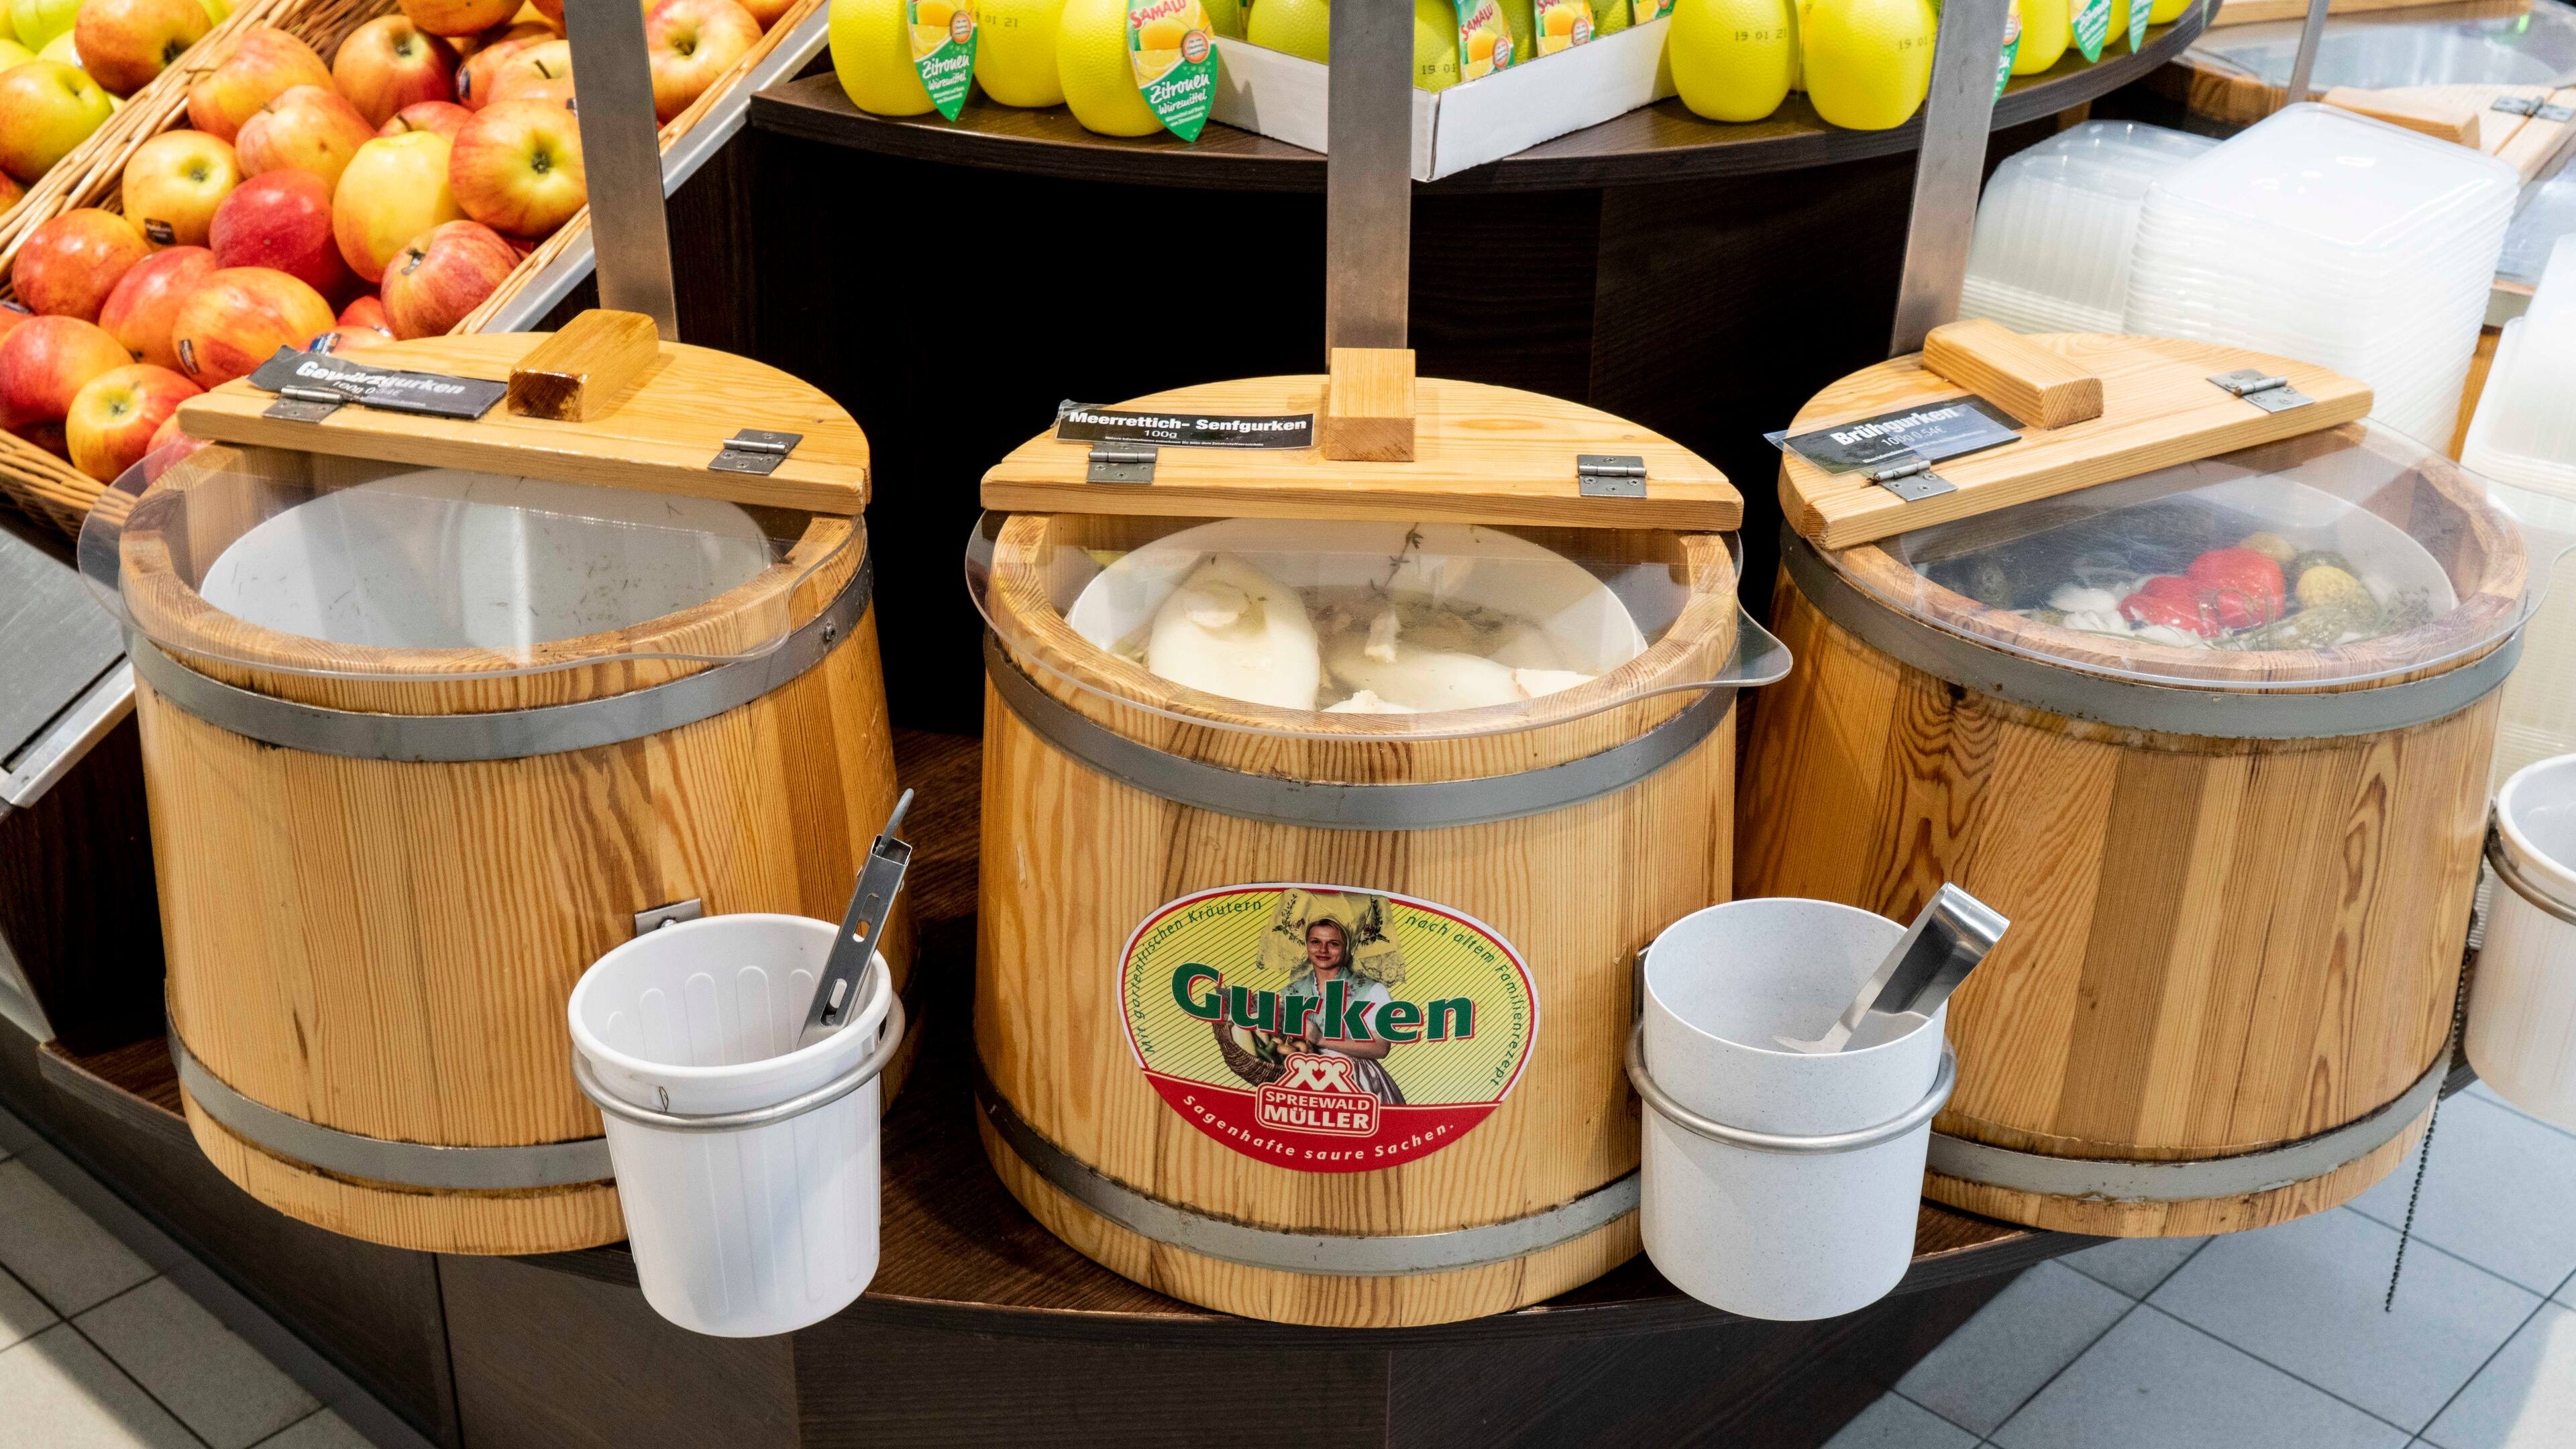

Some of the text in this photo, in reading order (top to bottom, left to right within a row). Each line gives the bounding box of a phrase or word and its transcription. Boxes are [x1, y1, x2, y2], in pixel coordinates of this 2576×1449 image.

[985, 15, 996, 25] 01
[1004, 17, 1018, 28] 21
[1130, 0, 1186, 29] SAMALU
[1460, 3, 1493, 42] SAMALU
[1735, 28, 1787, 41] 19 01 21
[1899, 39, 1911, 50] 19
[1918, 36, 1927, 46] 01
[922, 55, 970, 79] Zitronen
[1422, 64, 1456, 74] 19 01
[1150, 74, 1210, 104] Zitronen
[1159, 89, 1208, 115] Würzmittel
[296, 361, 466, 394] Gewürzgurken
[1069, 411, 1307, 433] Meerrettich- Senfgurken
[1144, 430, 1178, 439] 100g
[1829, 408, 1958, 445] Brühgurken
[1881, 433, 1916, 446] 100g
[1913, 425, 1947, 439] 0.54€
[1132, 900, 1263, 1053] Mit gartenfrischen Kräutern
[1171, 961, 1476, 1045] Gurken
[1405, 915, 1525, 1086] nach altem Familienrezept
[1265, 1091, 1370, 1111] SPREEWALD
[1183, 1094, 1454, 1161] Sagenhafte saure Sachen.
[1264, 1106, 1369, 1130] MÜLLER
